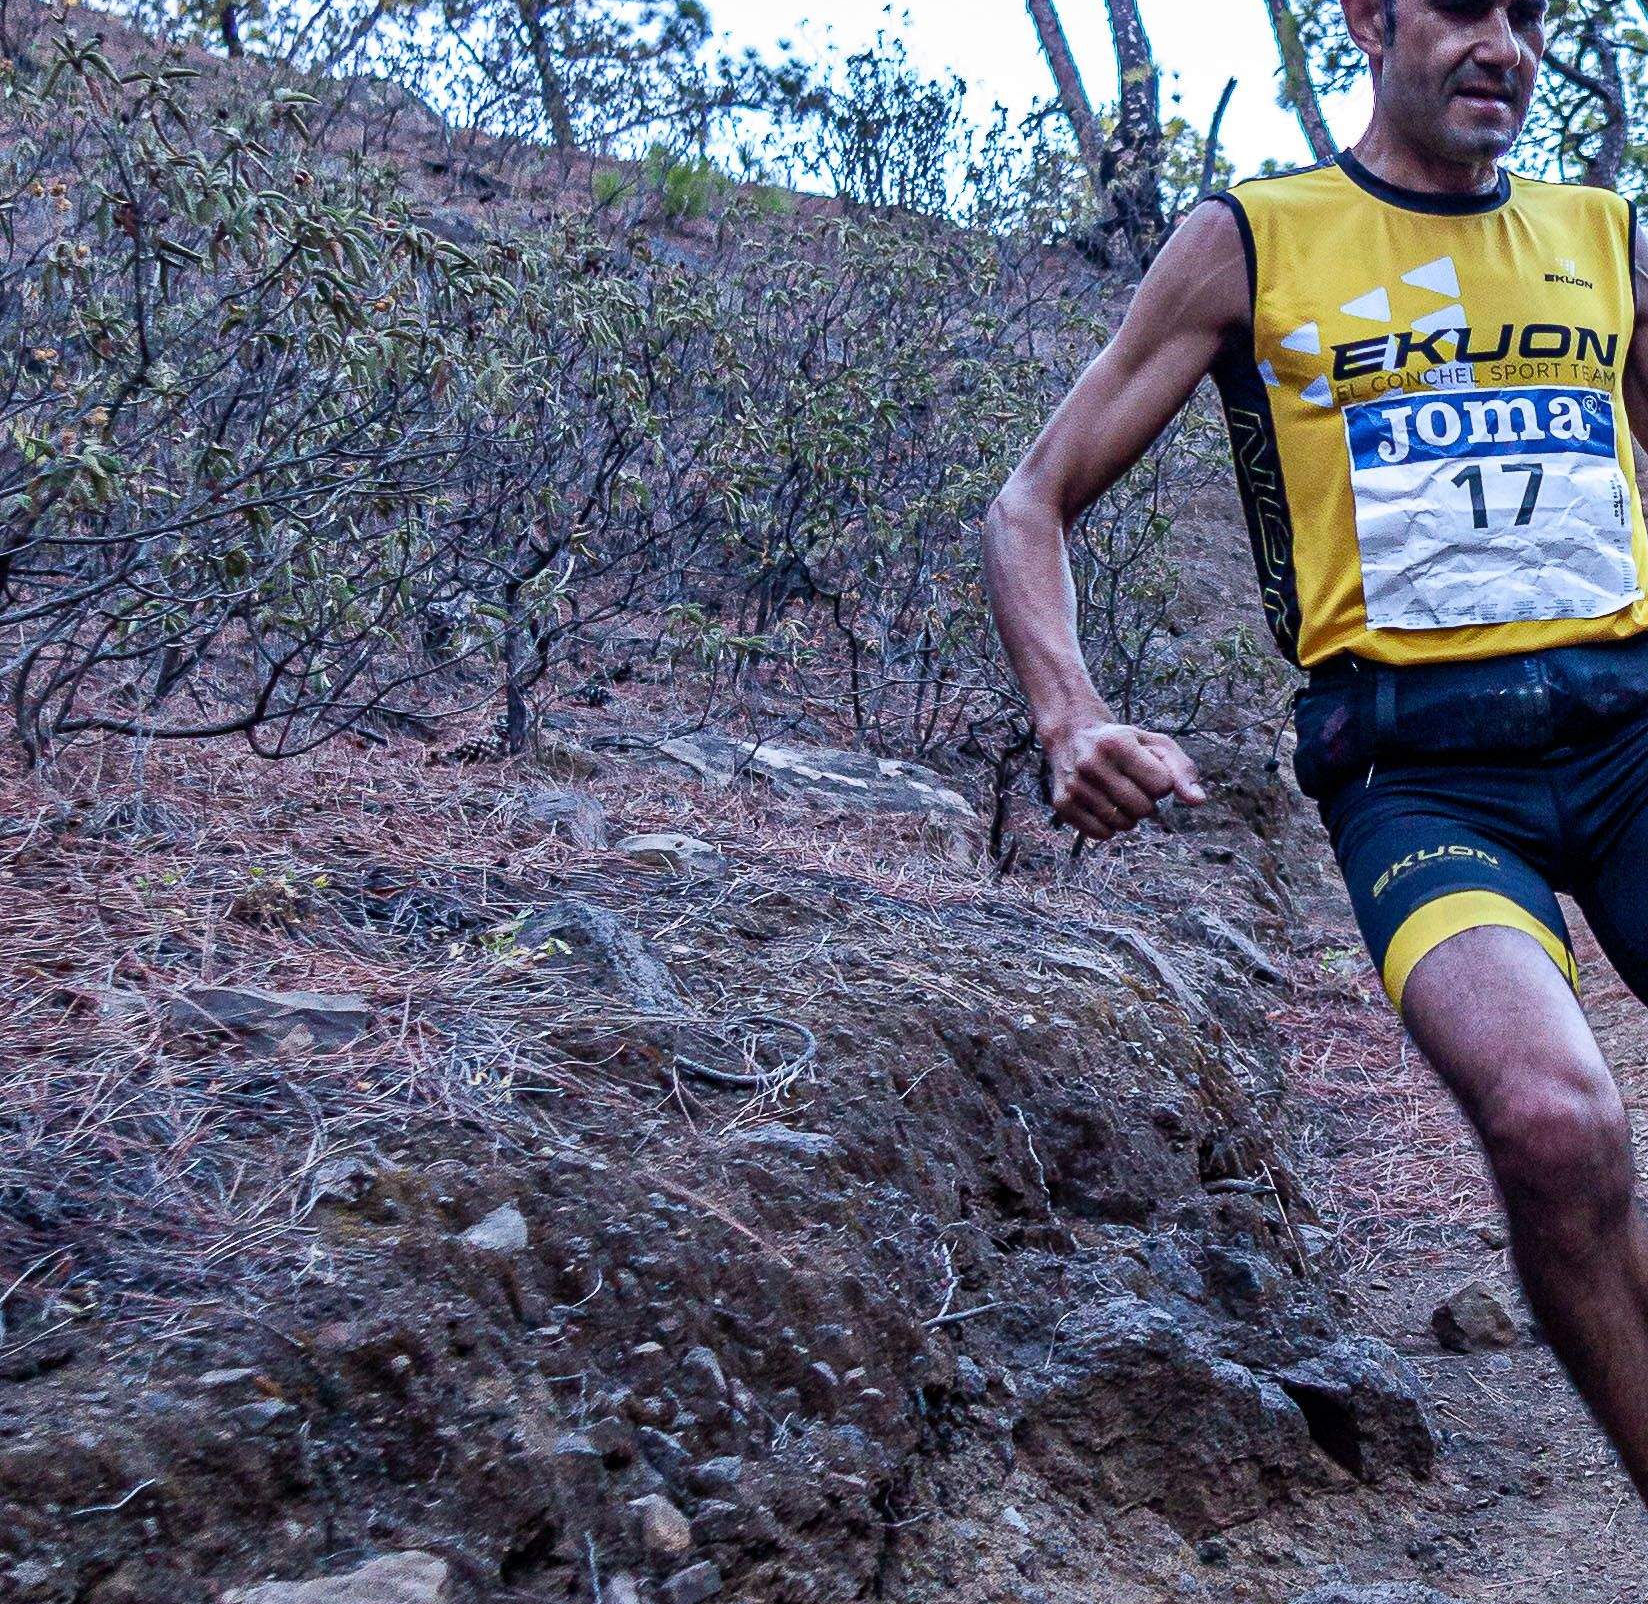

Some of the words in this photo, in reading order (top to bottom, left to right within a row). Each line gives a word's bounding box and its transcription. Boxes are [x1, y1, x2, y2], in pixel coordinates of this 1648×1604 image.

[1544, 273, 1593, 290] EKUON
[1330, 323, 1619, 381] EKUON
[1336, 383, 1361, 401] EL
[1371, 367, 1480, 393] CONCHEL
[1490, 362, 1562, 381] SPORT
[1570, 363, 1616, 386] TEAM
[1451, 463, 1544, 529] 17
[1373, 845, 1499, 898] EKUON
